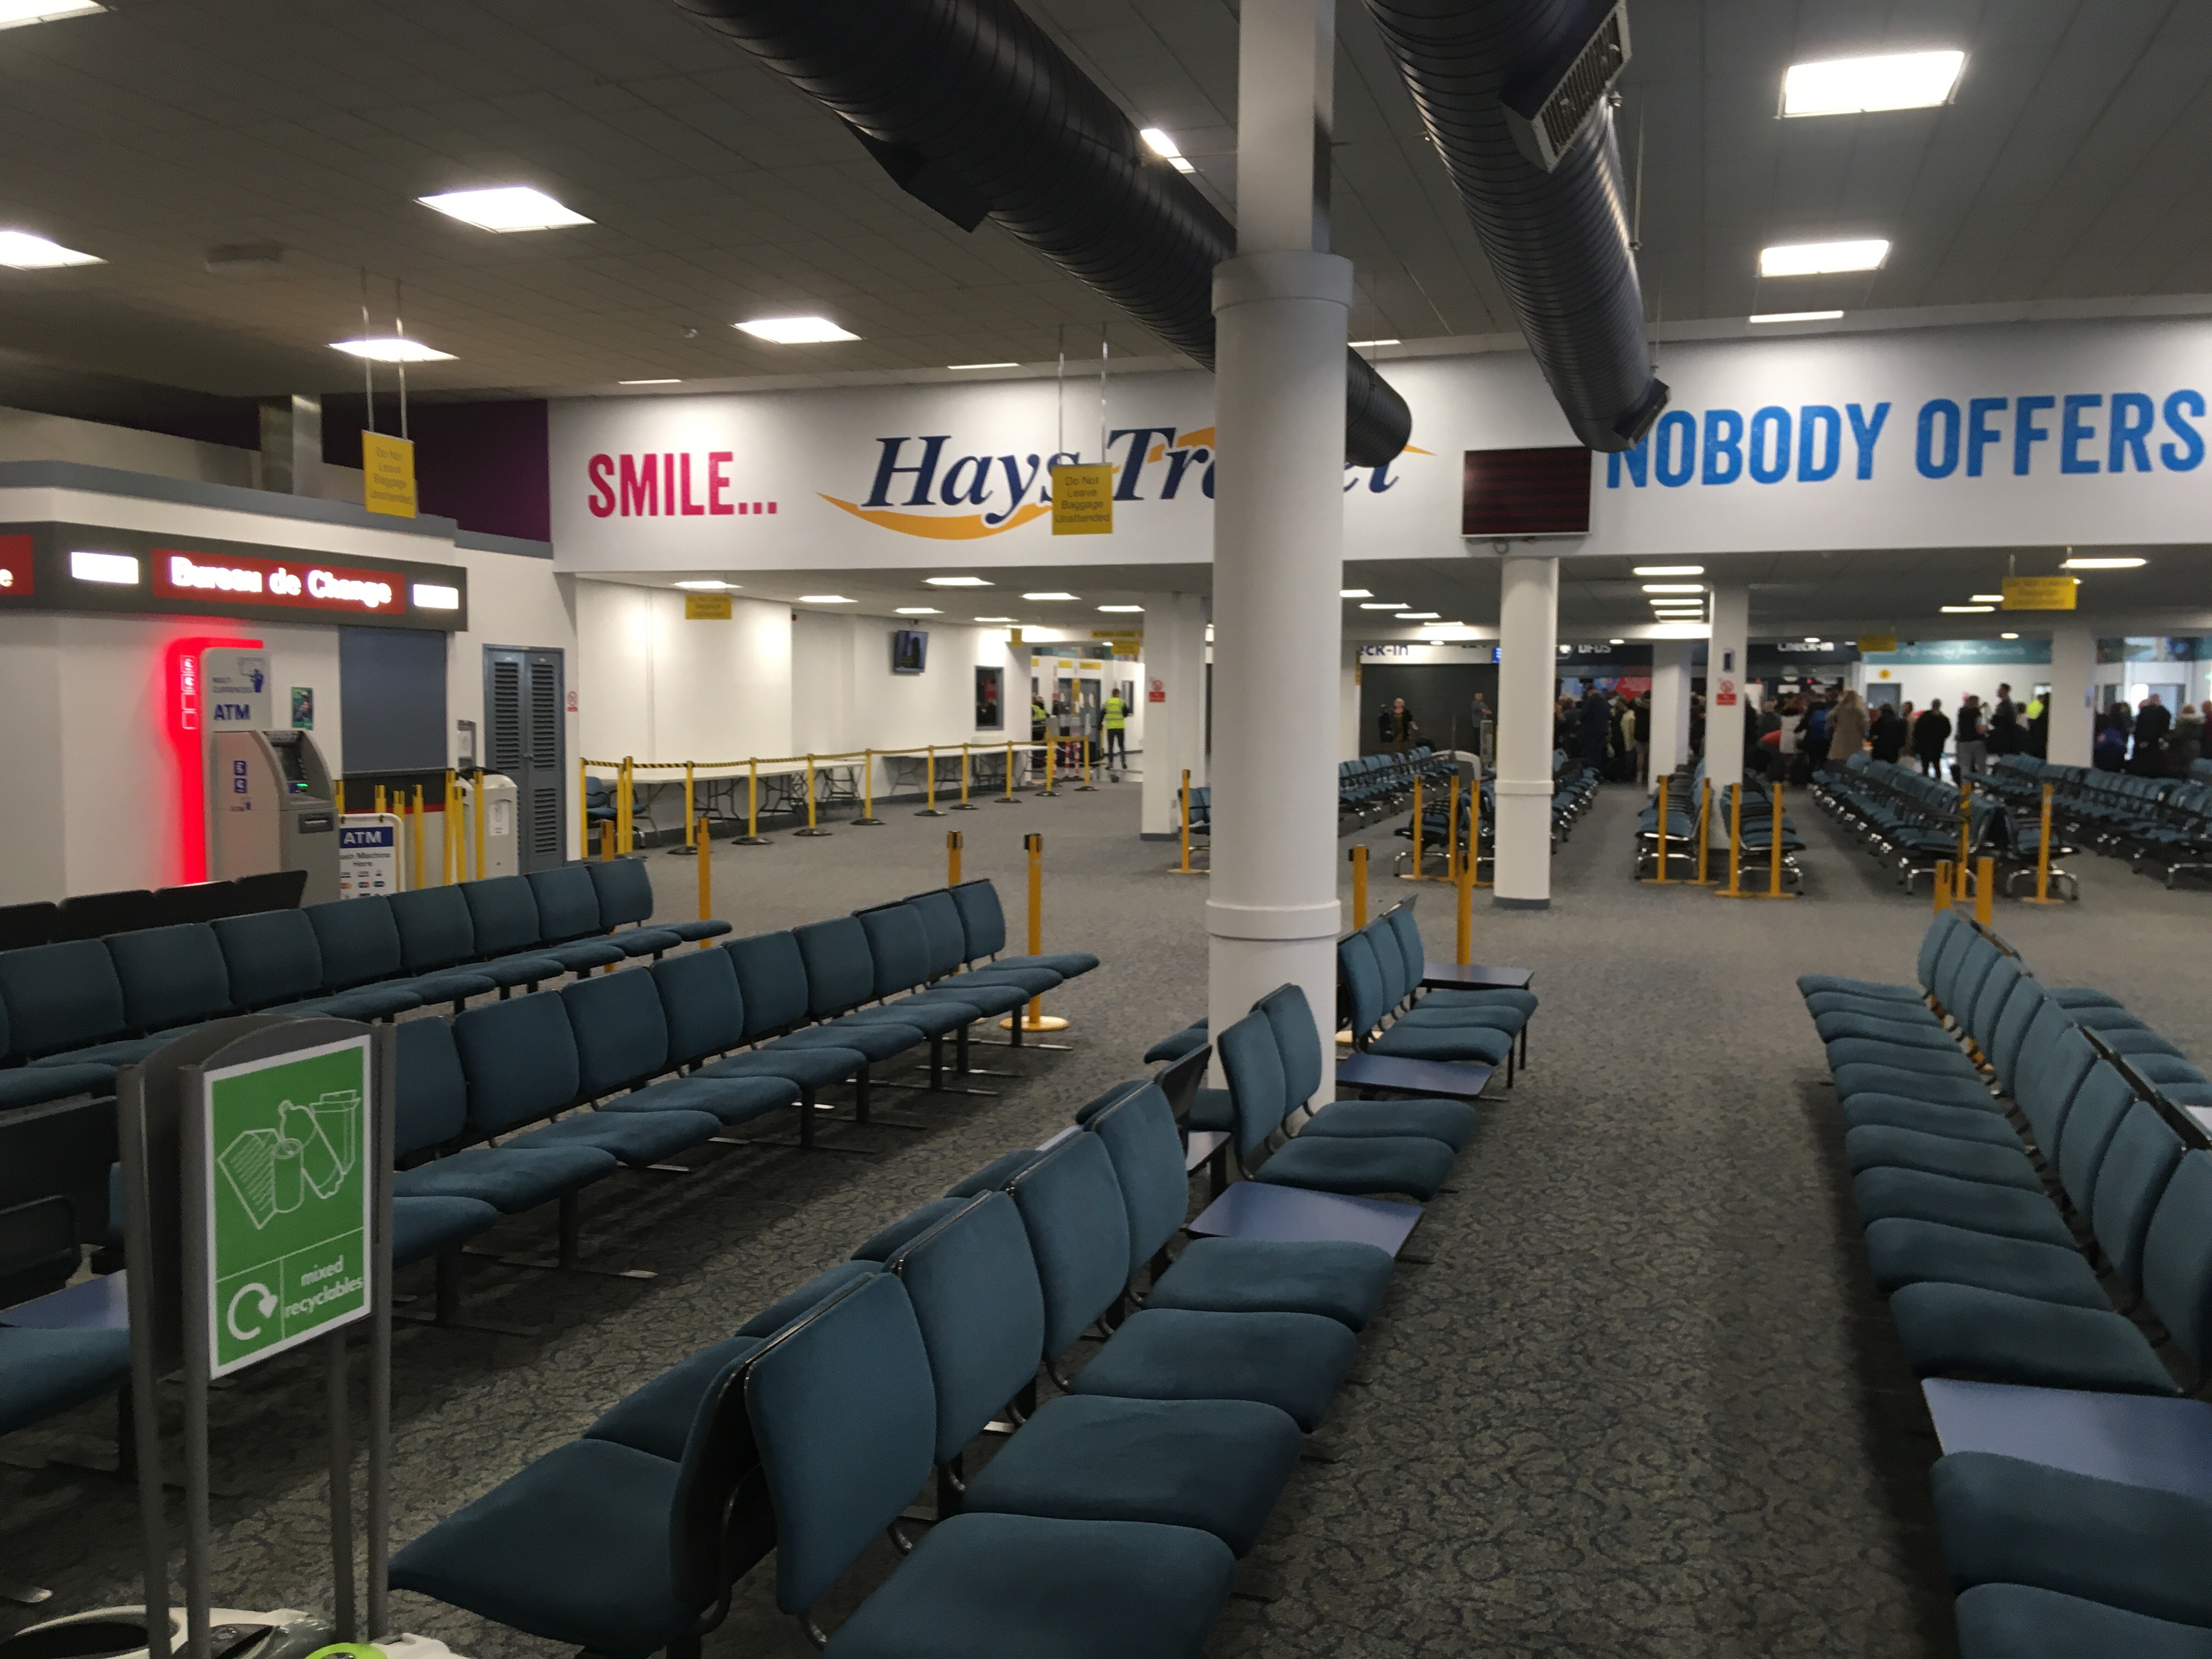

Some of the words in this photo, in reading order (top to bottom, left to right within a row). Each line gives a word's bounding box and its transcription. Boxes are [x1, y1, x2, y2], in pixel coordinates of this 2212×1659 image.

[1606, 402, 1893, 489] NOBODY
[1915, 389, 2206, 479] OFFERS
[588, 451, 777, 518] SMILE...
[1065, 476, 1079, 486] Do
[1082, 476, 1099, 484] Not
[1066, 489, 1097, 498] Leave
[1061, 500, 1104, 511] Baggage
[1054, 513, 1109, 523] Unattended
[171, 556, 263, 592] Bureau
[269, 567, 302, 595] de
[307, 569, 392, 608] Change
[213, 703, 250, 720] ATM
[343, 831, 382, 844] ATM
[301, 1255, 345, 1287] mixed
[285, 1276, 363, 1319] recyclables
